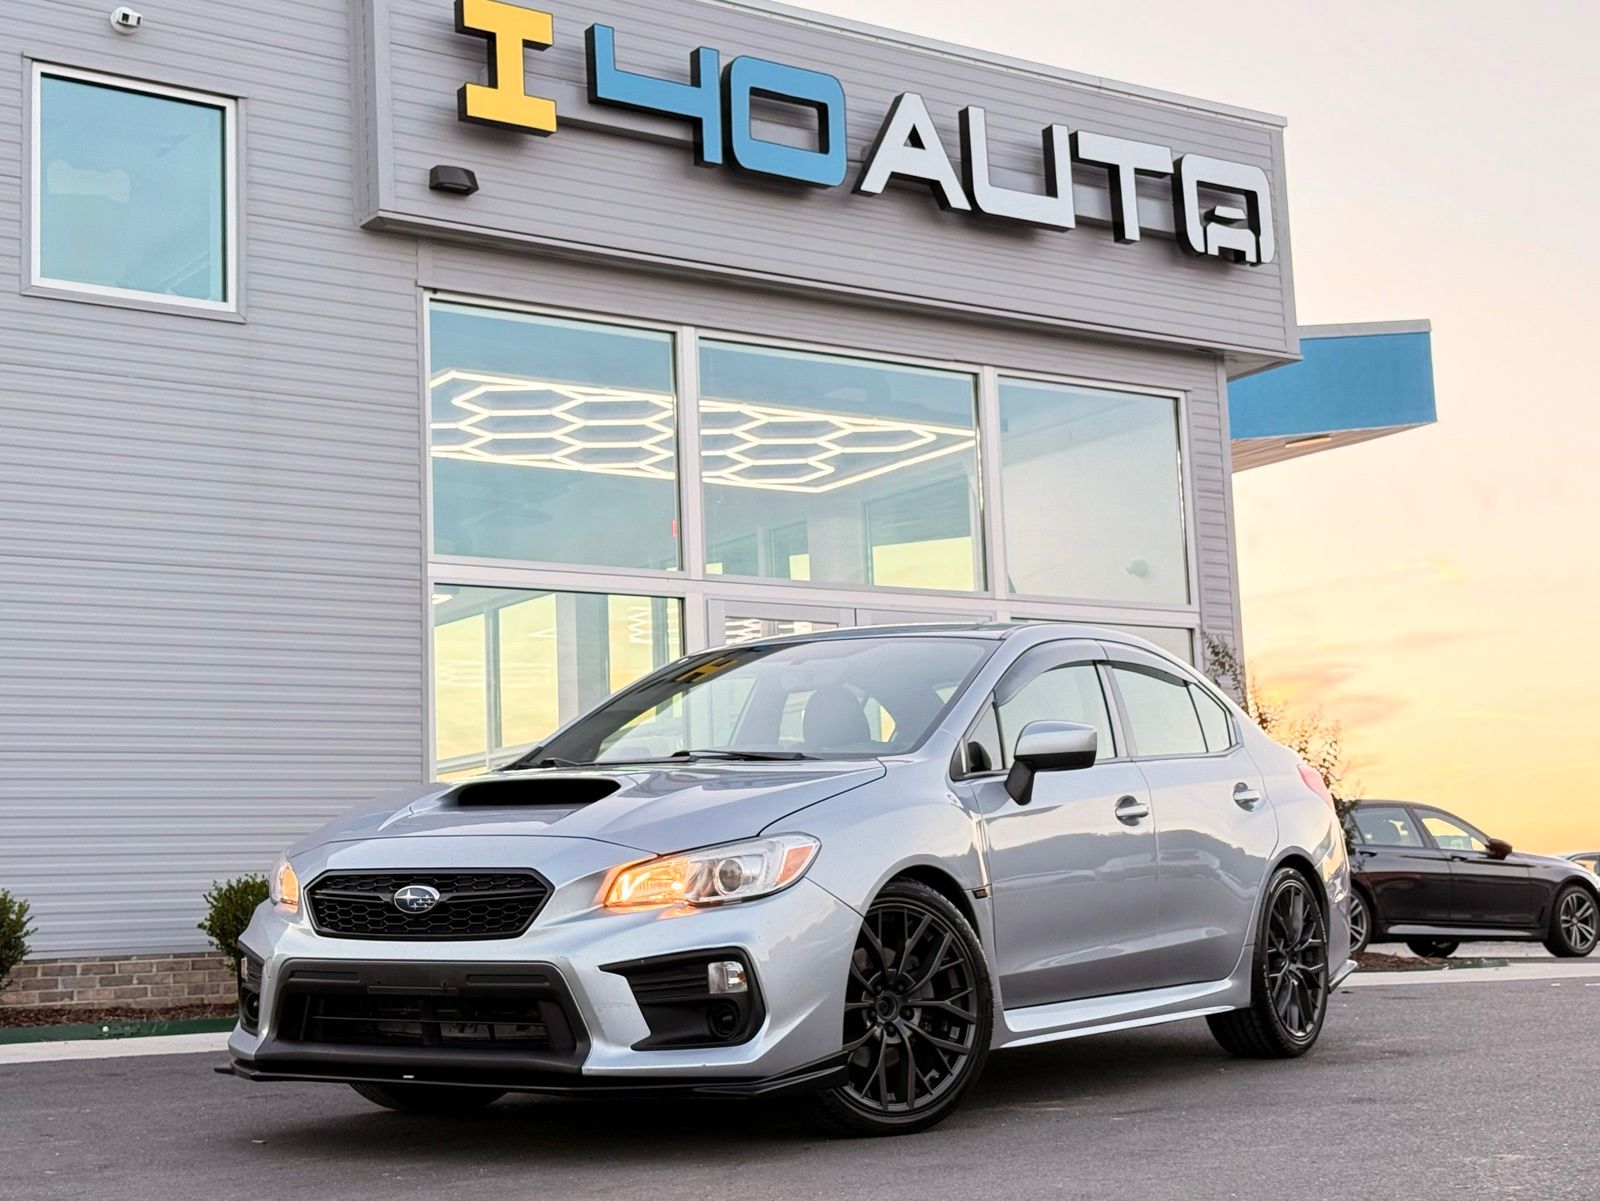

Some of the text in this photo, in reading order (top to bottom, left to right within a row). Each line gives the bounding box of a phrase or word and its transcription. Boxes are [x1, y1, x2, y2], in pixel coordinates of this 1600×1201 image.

[456, 0, 1275, 264] I 40 AUTO
